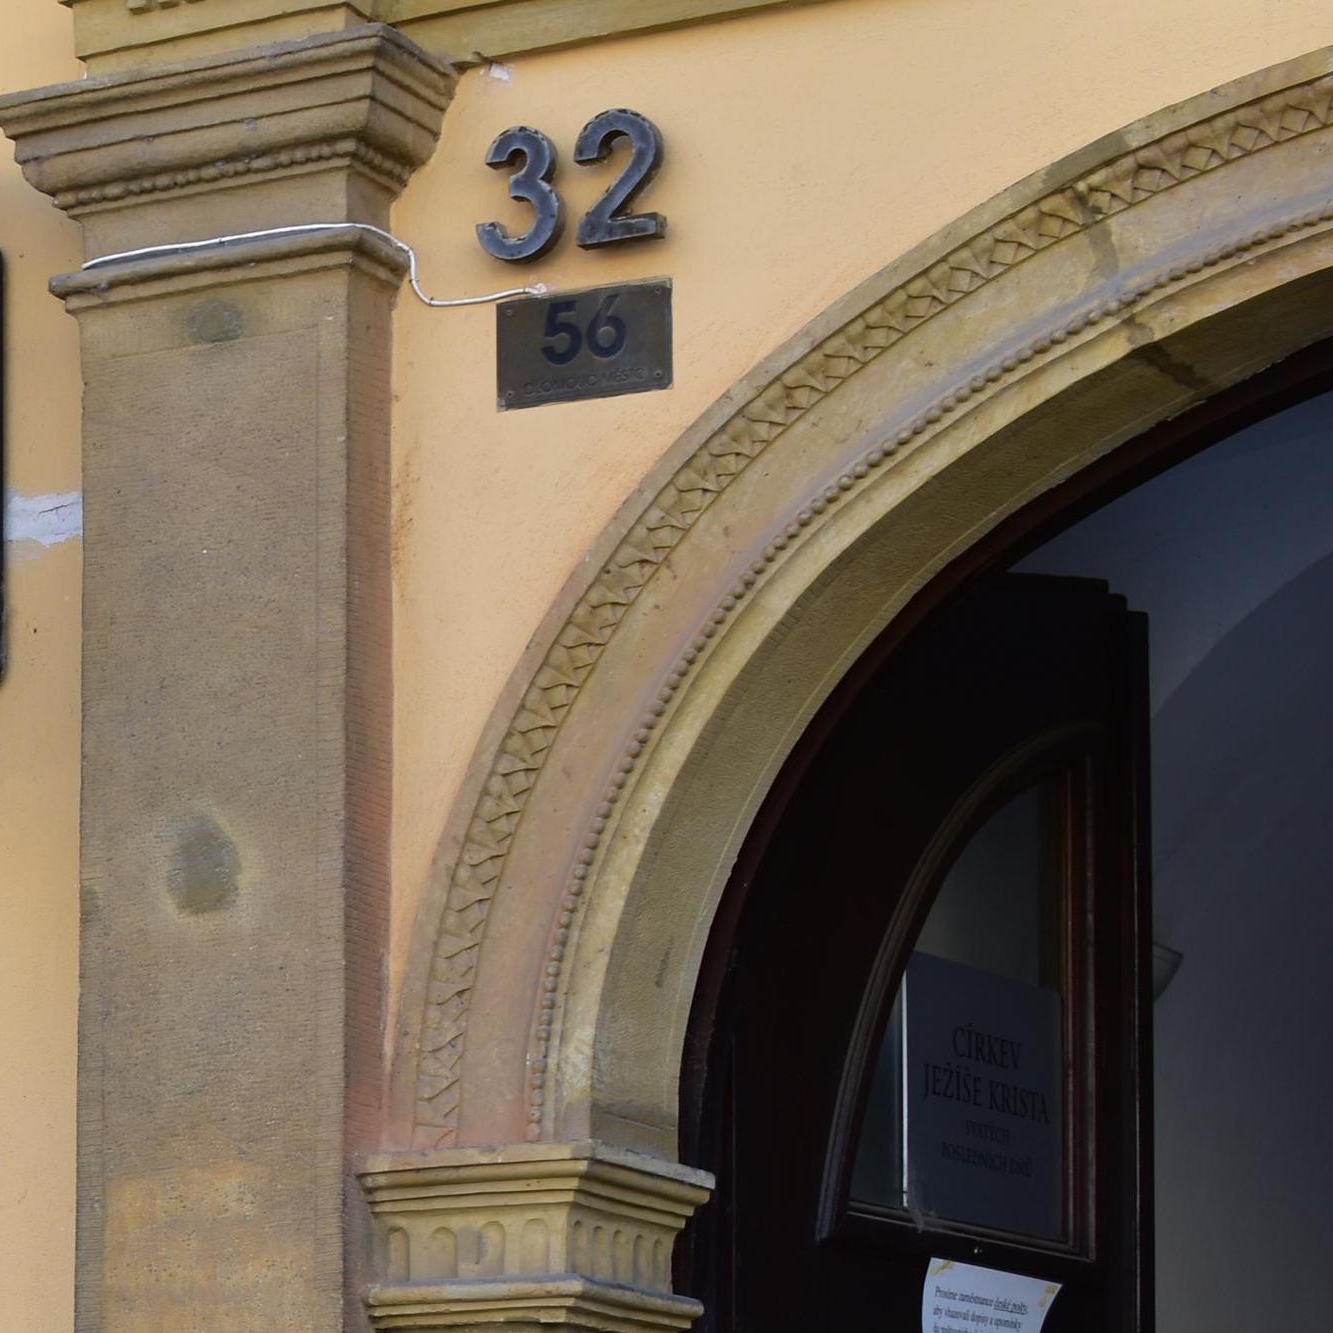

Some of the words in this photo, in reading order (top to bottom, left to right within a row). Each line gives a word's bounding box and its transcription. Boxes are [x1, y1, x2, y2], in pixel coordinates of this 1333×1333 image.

[476, 108, 668, 264] 32
[539, 291, 628, 366] 56
[988, 1080, 1051, 1126] KRISTA
